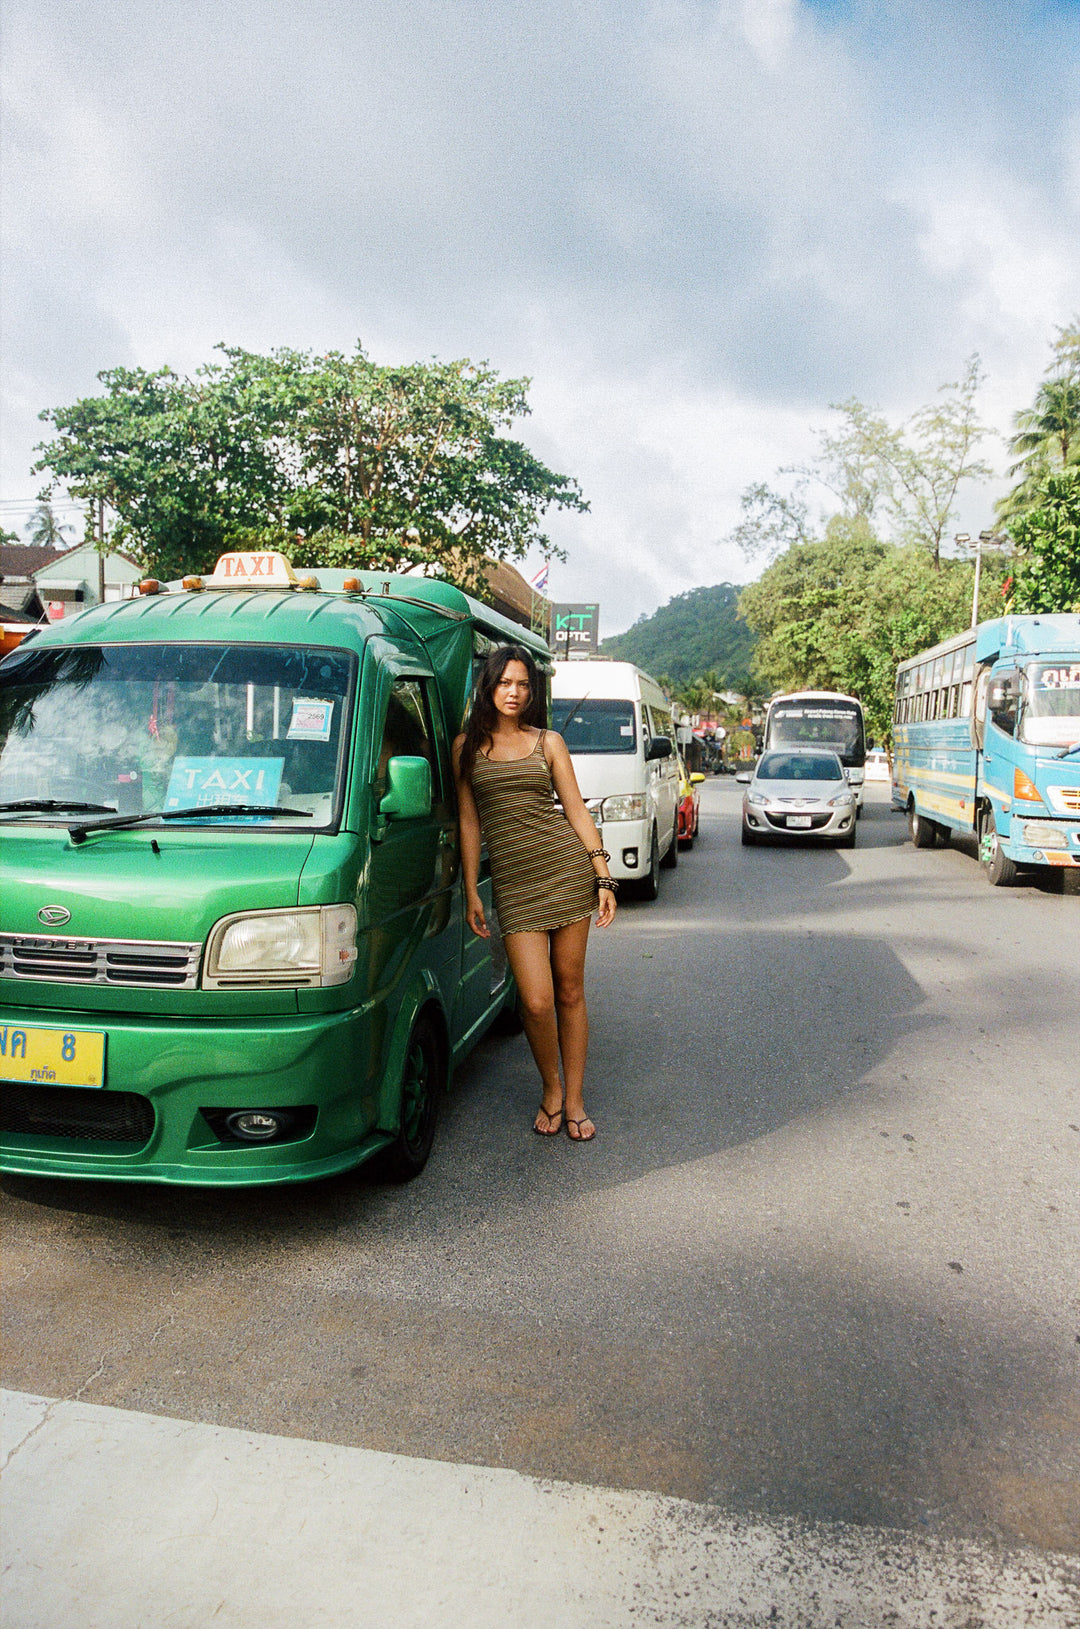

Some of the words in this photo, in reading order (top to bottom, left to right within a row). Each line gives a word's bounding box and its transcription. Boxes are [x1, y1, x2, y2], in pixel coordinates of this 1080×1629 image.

[221, 556, 275, 577] TAXI
[556, 613, 592, 631] KT
[556, 631, 591, 642] OPTIC
[184, 769, 265, 790] TAXI
[12, 937, 97, 951] HIJET
[62, 1033, 76, 1062] 8
